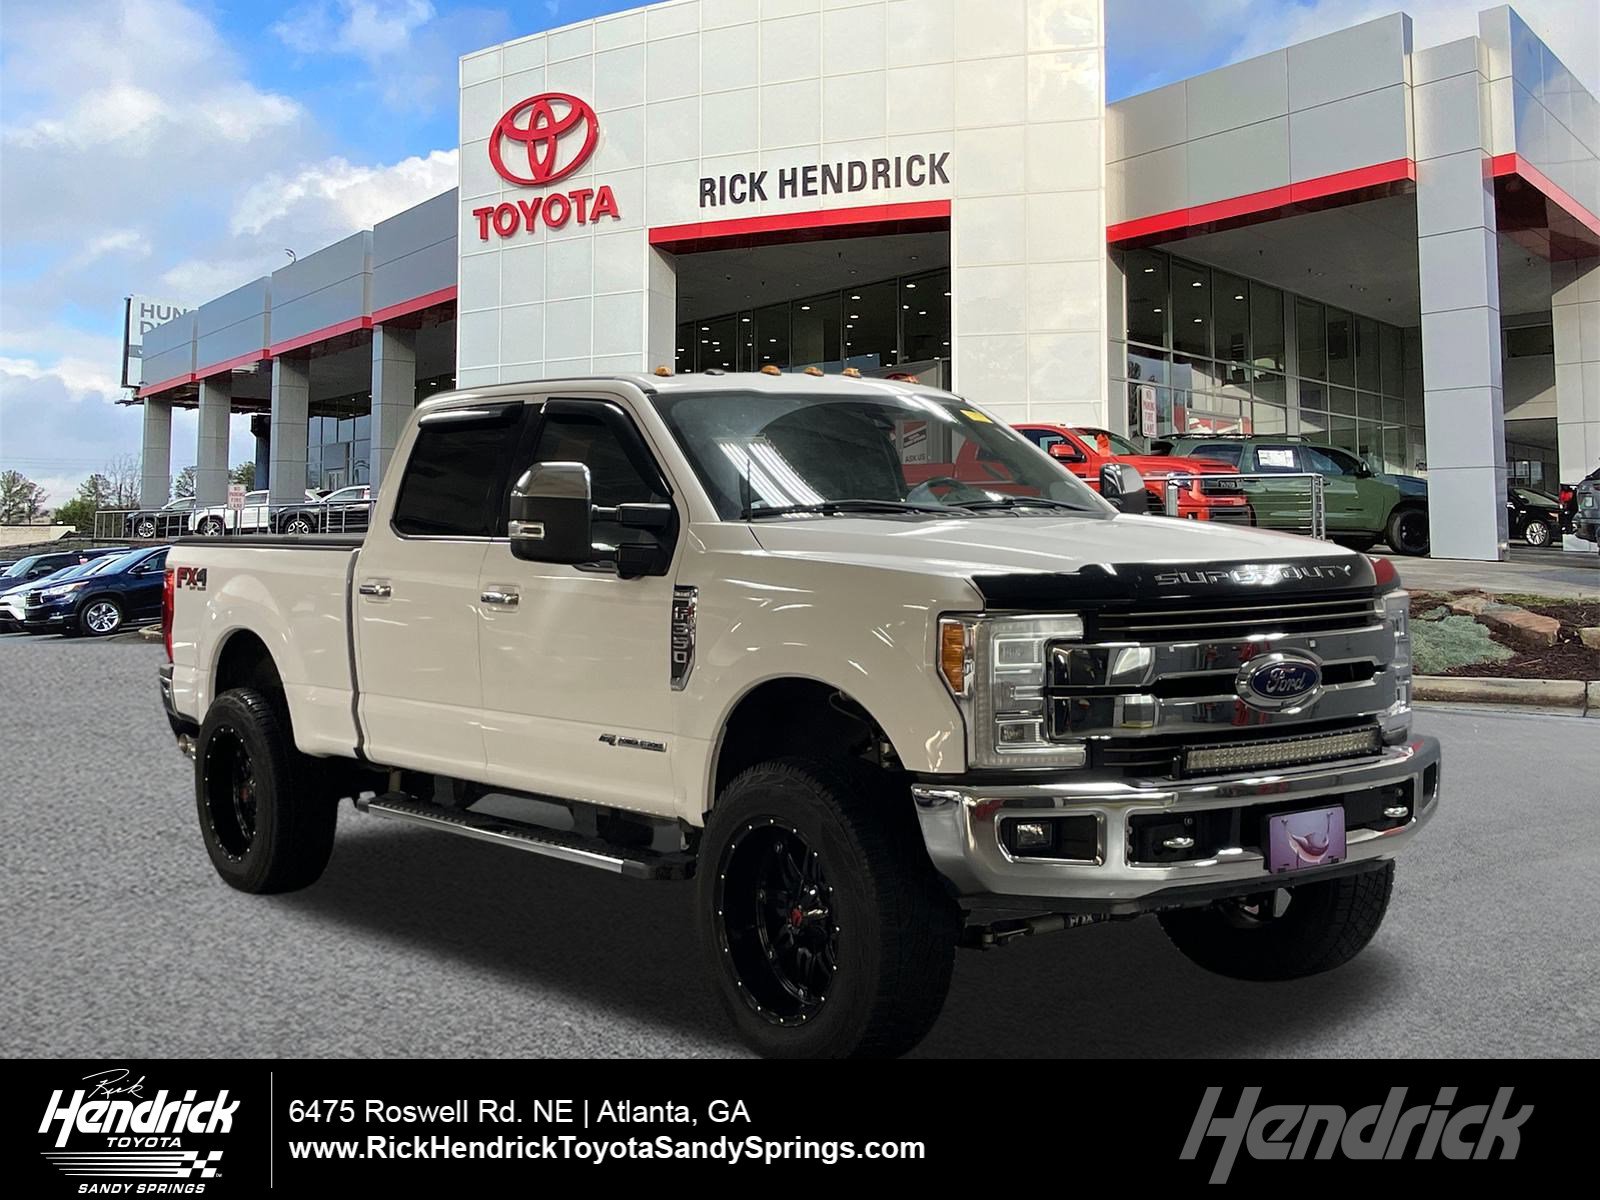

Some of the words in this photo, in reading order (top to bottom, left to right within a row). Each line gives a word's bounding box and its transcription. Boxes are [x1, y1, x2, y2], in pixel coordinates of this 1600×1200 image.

[700, 170, 768, 208] RICK
[778, 152, 950, 199] HENDRICK
[473, 185, 621, 241] TOYOTA
[177, 567, 207, 588] FX4
[1282, 564, 1351, 579] DUTY
[1266, 667, 1306, 693] Ford
